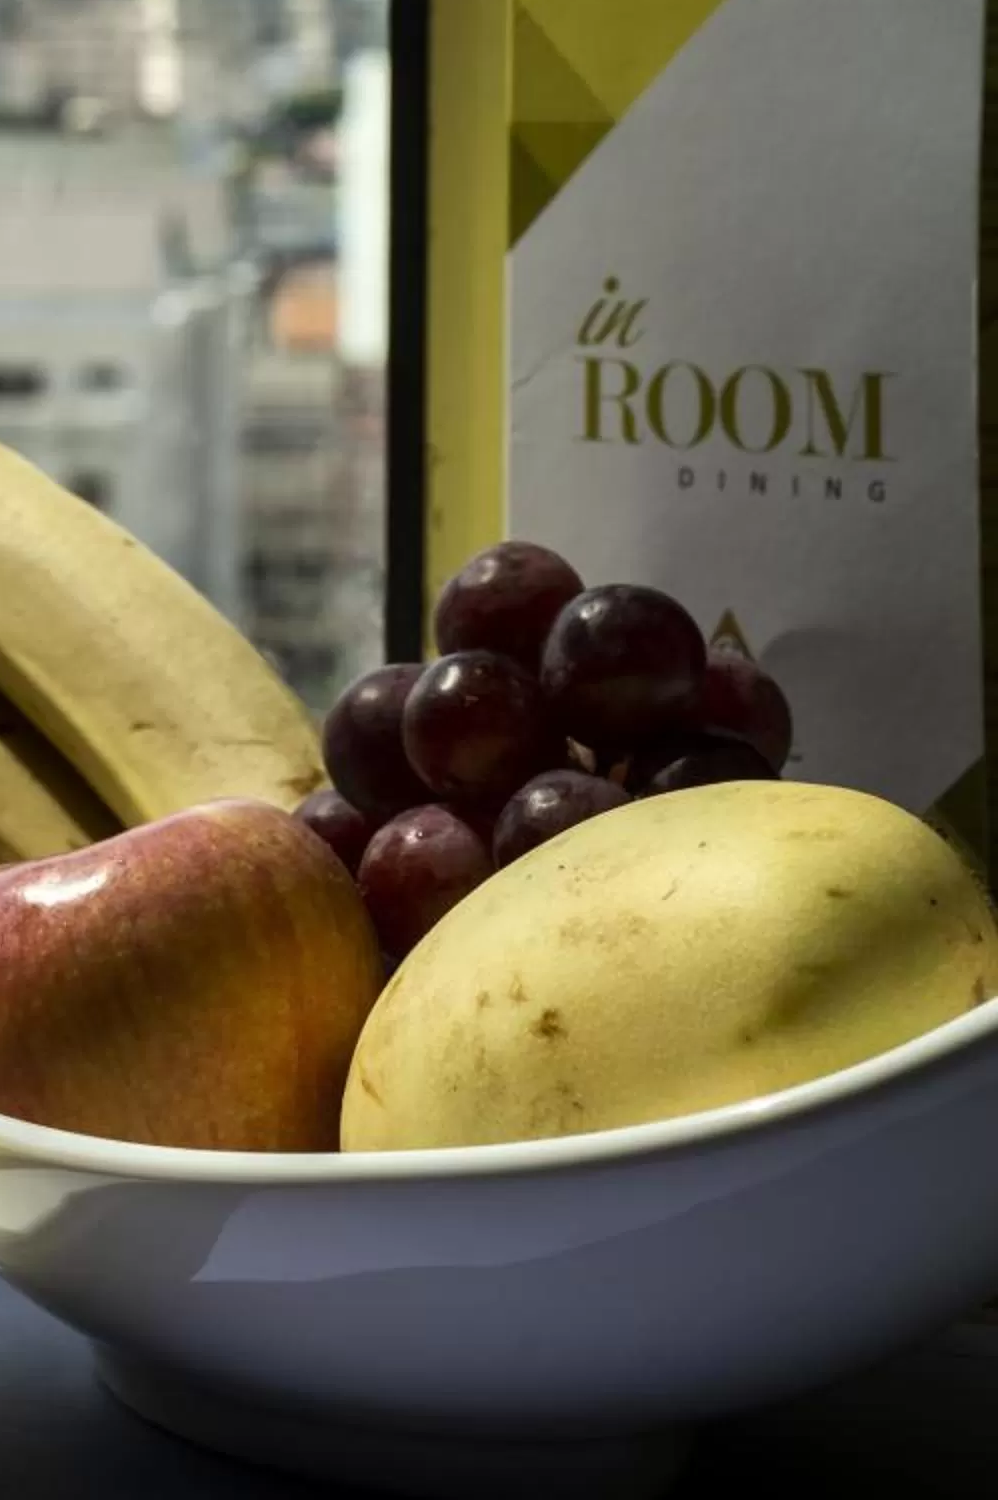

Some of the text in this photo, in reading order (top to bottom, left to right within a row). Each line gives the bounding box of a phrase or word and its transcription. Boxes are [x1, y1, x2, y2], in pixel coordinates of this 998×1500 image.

[576, 276, 649, 348] in
[574, 355, 899, 463] ROOM
[677, 467, 886, 502] DINING
